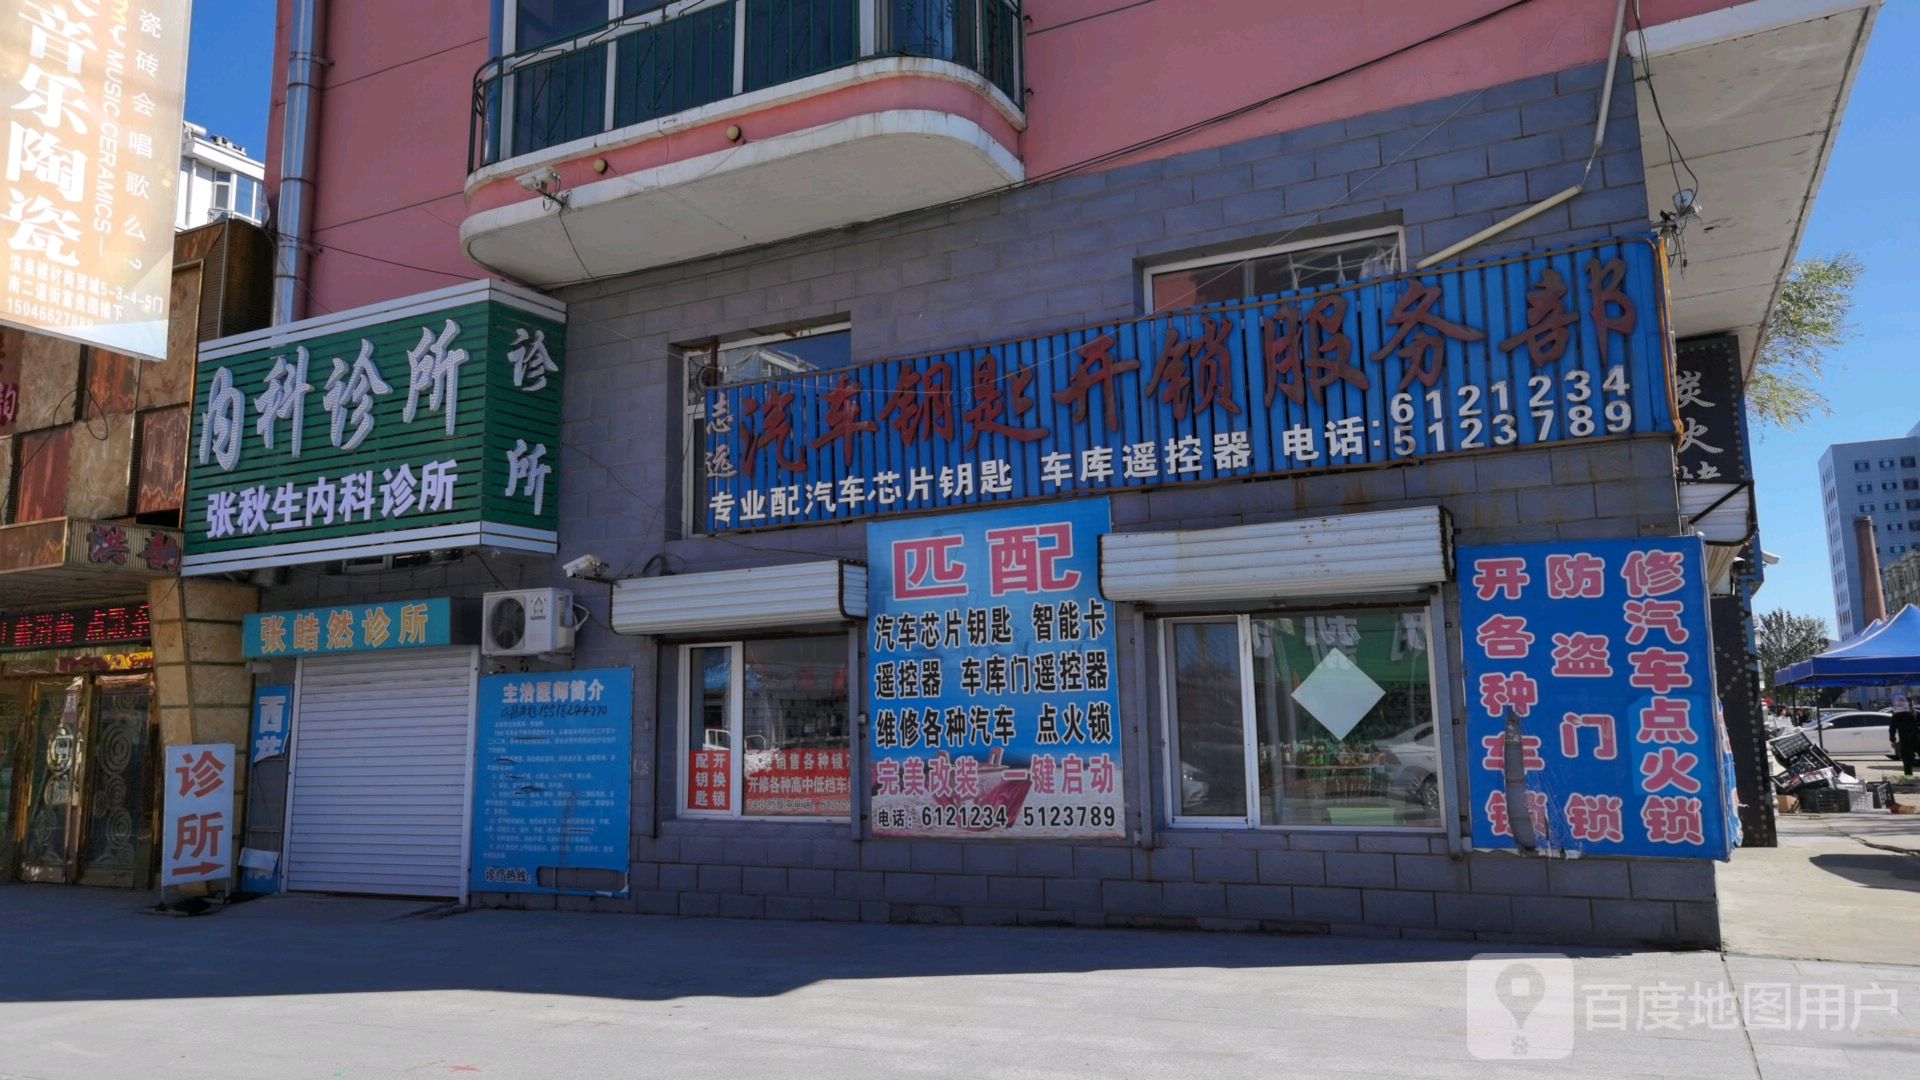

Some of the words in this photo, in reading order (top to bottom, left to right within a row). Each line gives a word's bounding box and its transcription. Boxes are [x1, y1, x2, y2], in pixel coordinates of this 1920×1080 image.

[103, 48, 125, 118] MUSIC
[0, 0, 98, 267] 音乐陶瓷
[93, 121, 120, 236] CERAMICS
[199, 318, 470, 472] 内科诊所
[739, 256, 1638, 478] 汽车钥匙开锁服务部
[504, 328, 560, 516] 诊所
[708, 459, 1013, 523] 专业配汽车芯片钥匙
[1040, 431, 1254, 488] 车库遥控器
[1390, 364, 1632, 423] 6121234
[1391, 400, 1633, 457] 5123789
[205, 458, 459, 539] 张秋生内科诊所
[891, 521, 1082, 601] 匹配
[875, 606, 1013, 652] 汽车芯片钥匙
[1032, 599, 1107, 643] 智能卡
[502, 679, 605, 704] 主治医师简介
[875, 657, 943, 700] 遥控器
[960, 650, 1109, 696] 车库门遥控器
[1545, 552, 1625, 842] 防盗门锁
[1620, 550, 1705, 845] 修汽车点火锁
[764, 752, 850, 771] 销售各种锁
[875, 705, 1016, 749] 维修各种汽车
[1036, 701, 1114, 745] 点火锁
[171, 750, 227, 860] 诊所
[694, 752, 709, 807] 配钥匙
[712, 752, 727, 808] 开换锁
[876, 757, 980, 798] 完美改装
[1001, 753, 1116, 796] 一键启动
[878, 809, 914, 828] 电话:
[920, 805, 1008, 828] 6121234
[1023, 805, 1117, 828] 5123789
